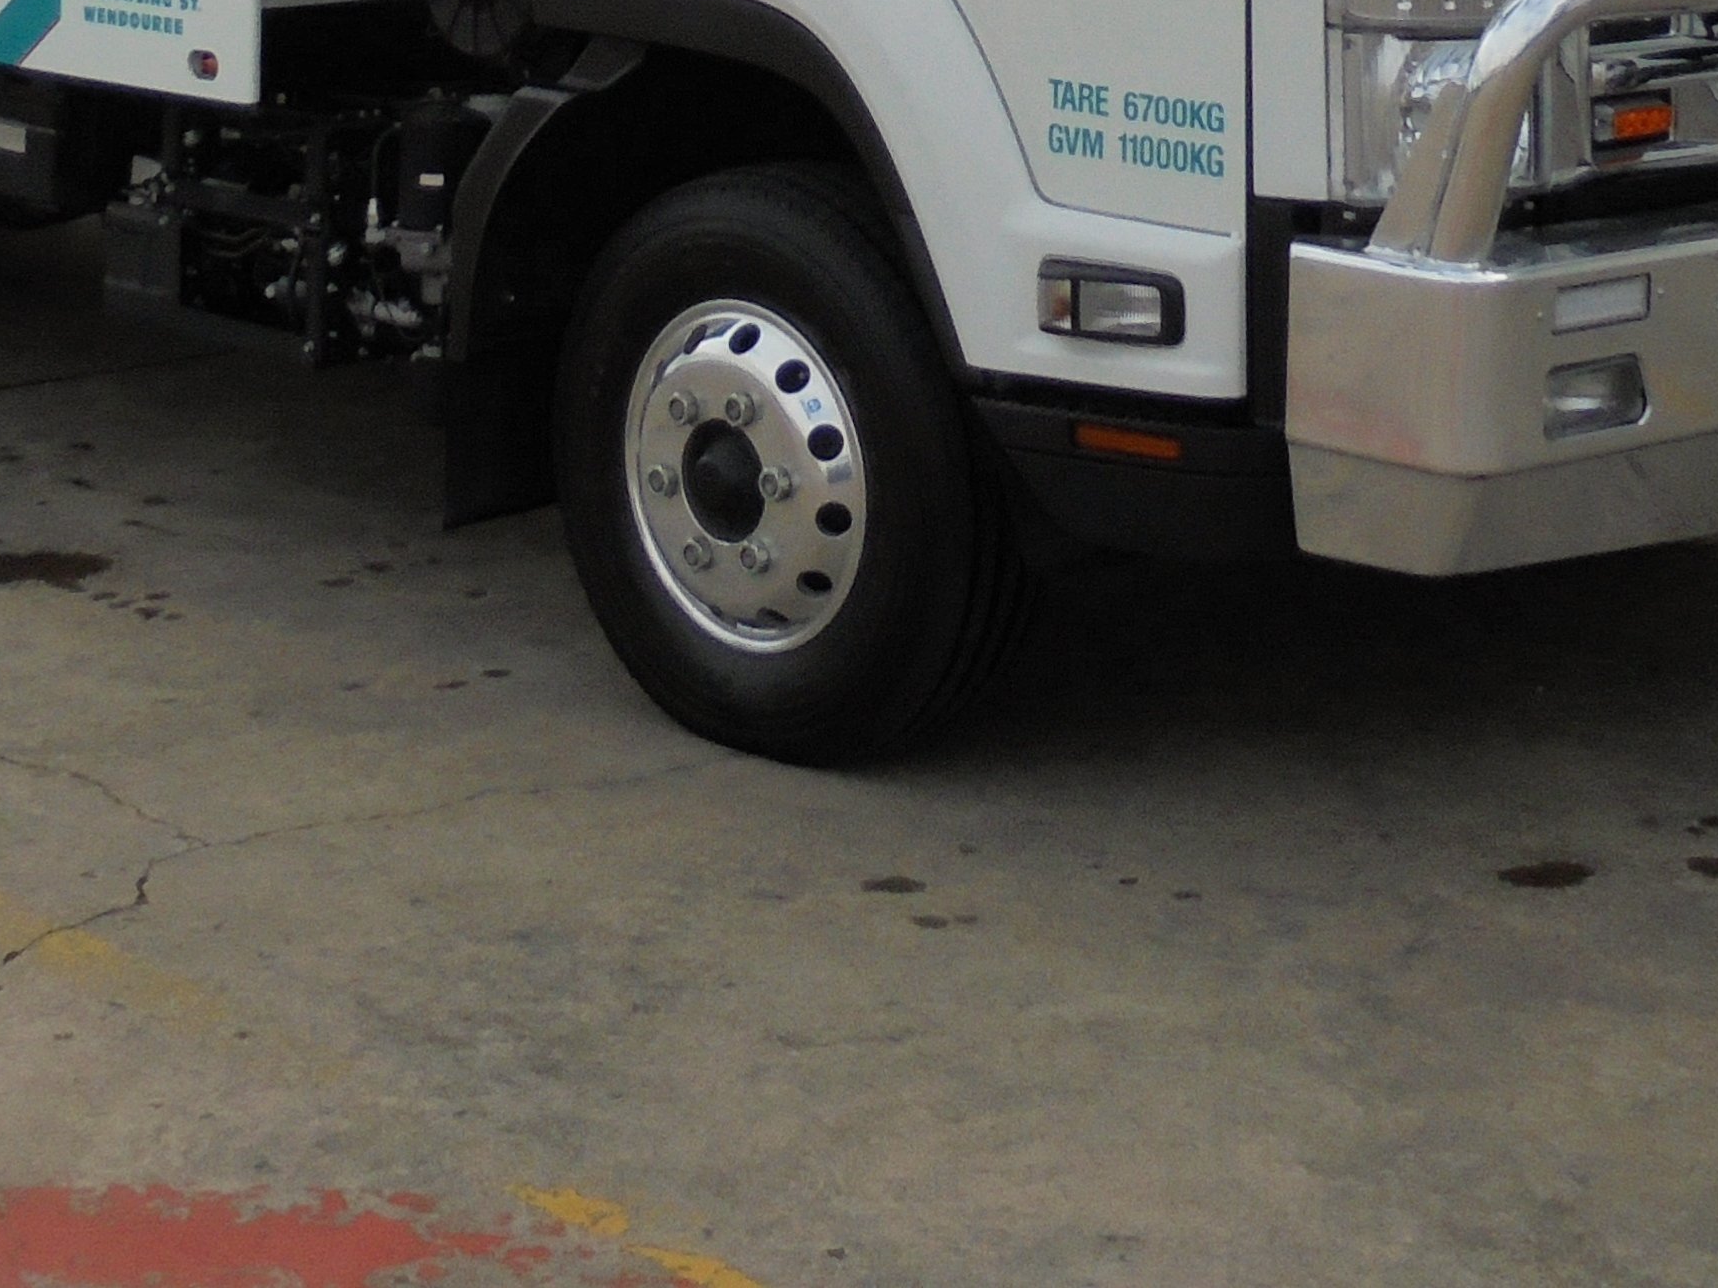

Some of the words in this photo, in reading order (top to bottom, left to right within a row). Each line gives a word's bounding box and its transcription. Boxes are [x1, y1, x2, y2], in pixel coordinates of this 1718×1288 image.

[84, 6, 183, 35] WENDOUREE
[1048, 78, 1109, 117] TARE
[1123, 91, 1225, 133] 6700KG
[1048, 123, 1104, 160] GVM
[1118, 132, 1225, 177] 11000KG
